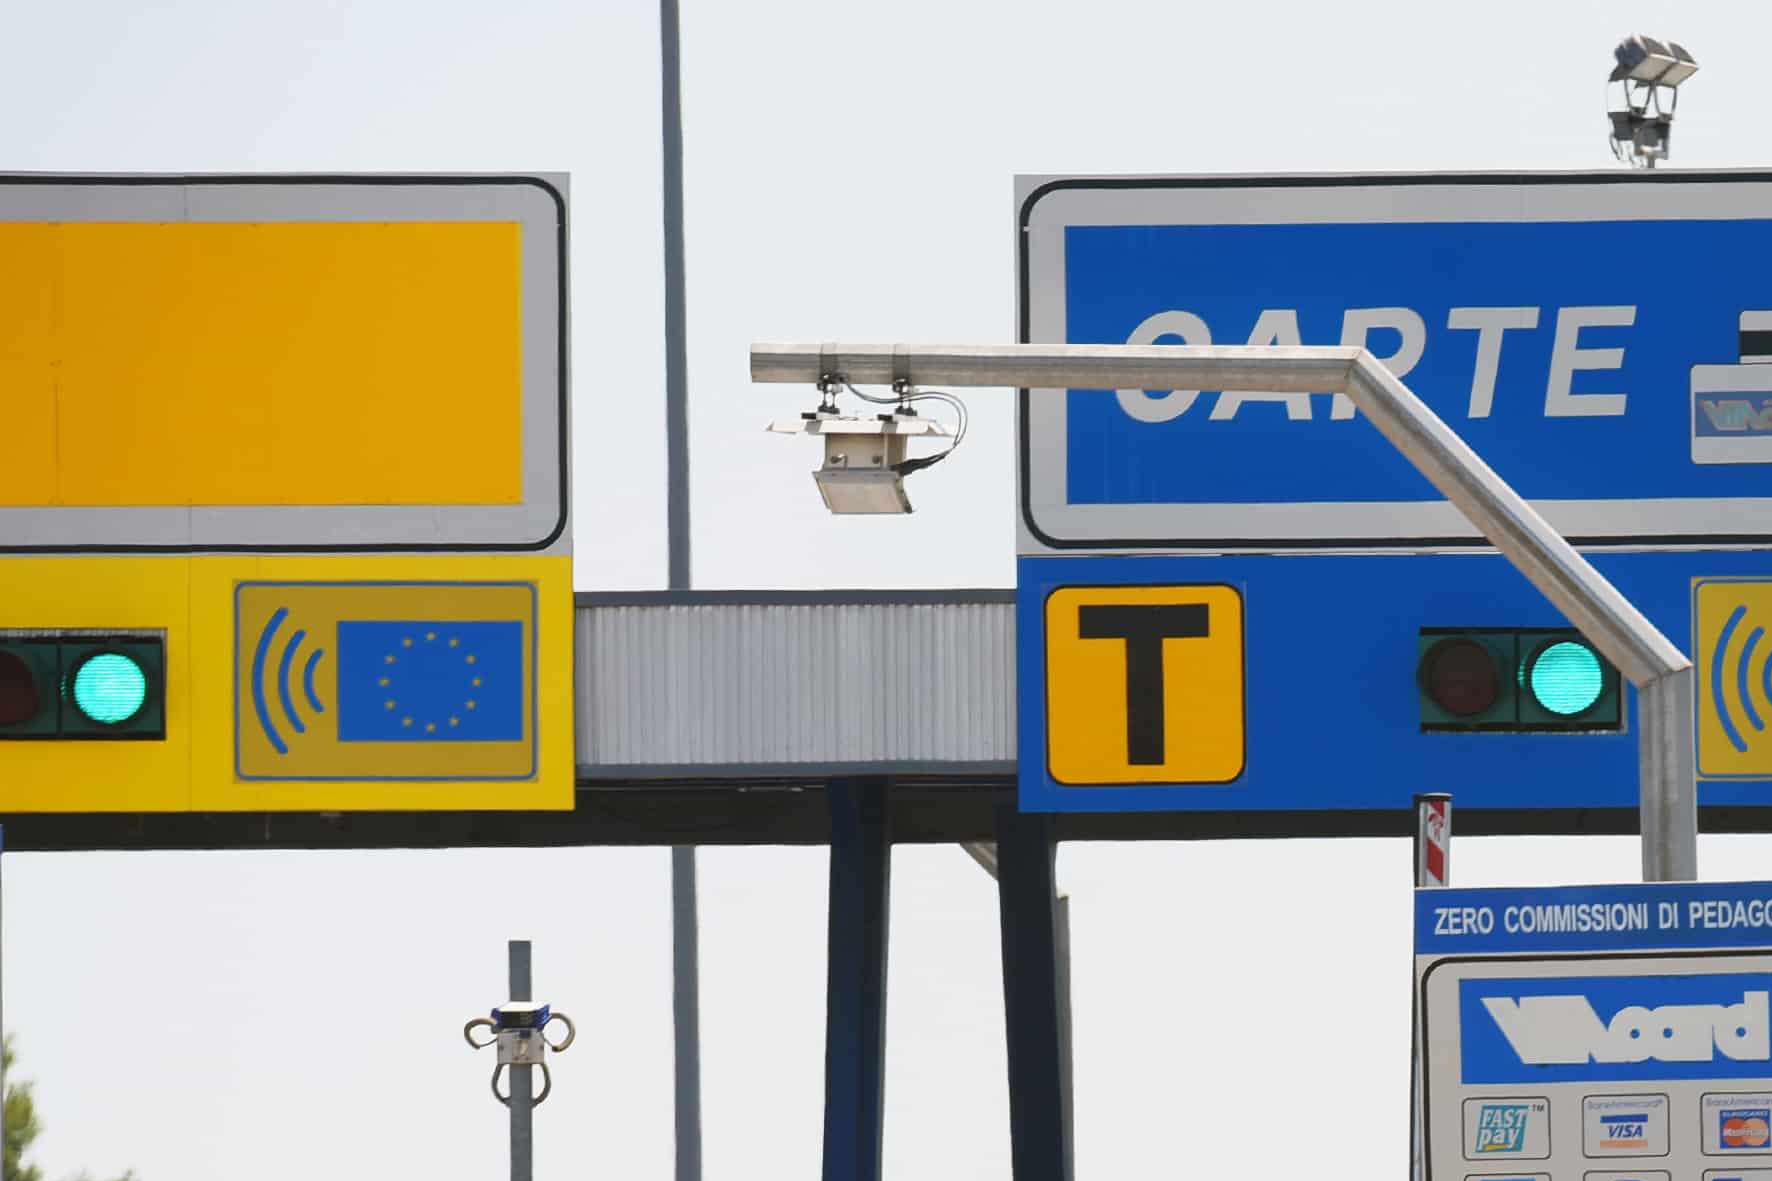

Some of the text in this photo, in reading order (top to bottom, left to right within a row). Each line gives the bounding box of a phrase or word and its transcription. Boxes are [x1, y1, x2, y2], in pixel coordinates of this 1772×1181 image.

[1115, 305, 1637, 423] CARTE
[1078, 604, 1209, 765] T
[1434, 907, 1494, 936] ZERO
[1504, 903, 1648, 934] COMMISSIONI
[1659, 902, 1679, 929] DI
[1482, 1109, 1528, 1128] FAST
[1608, 1124, 1644, 1138] VISA
